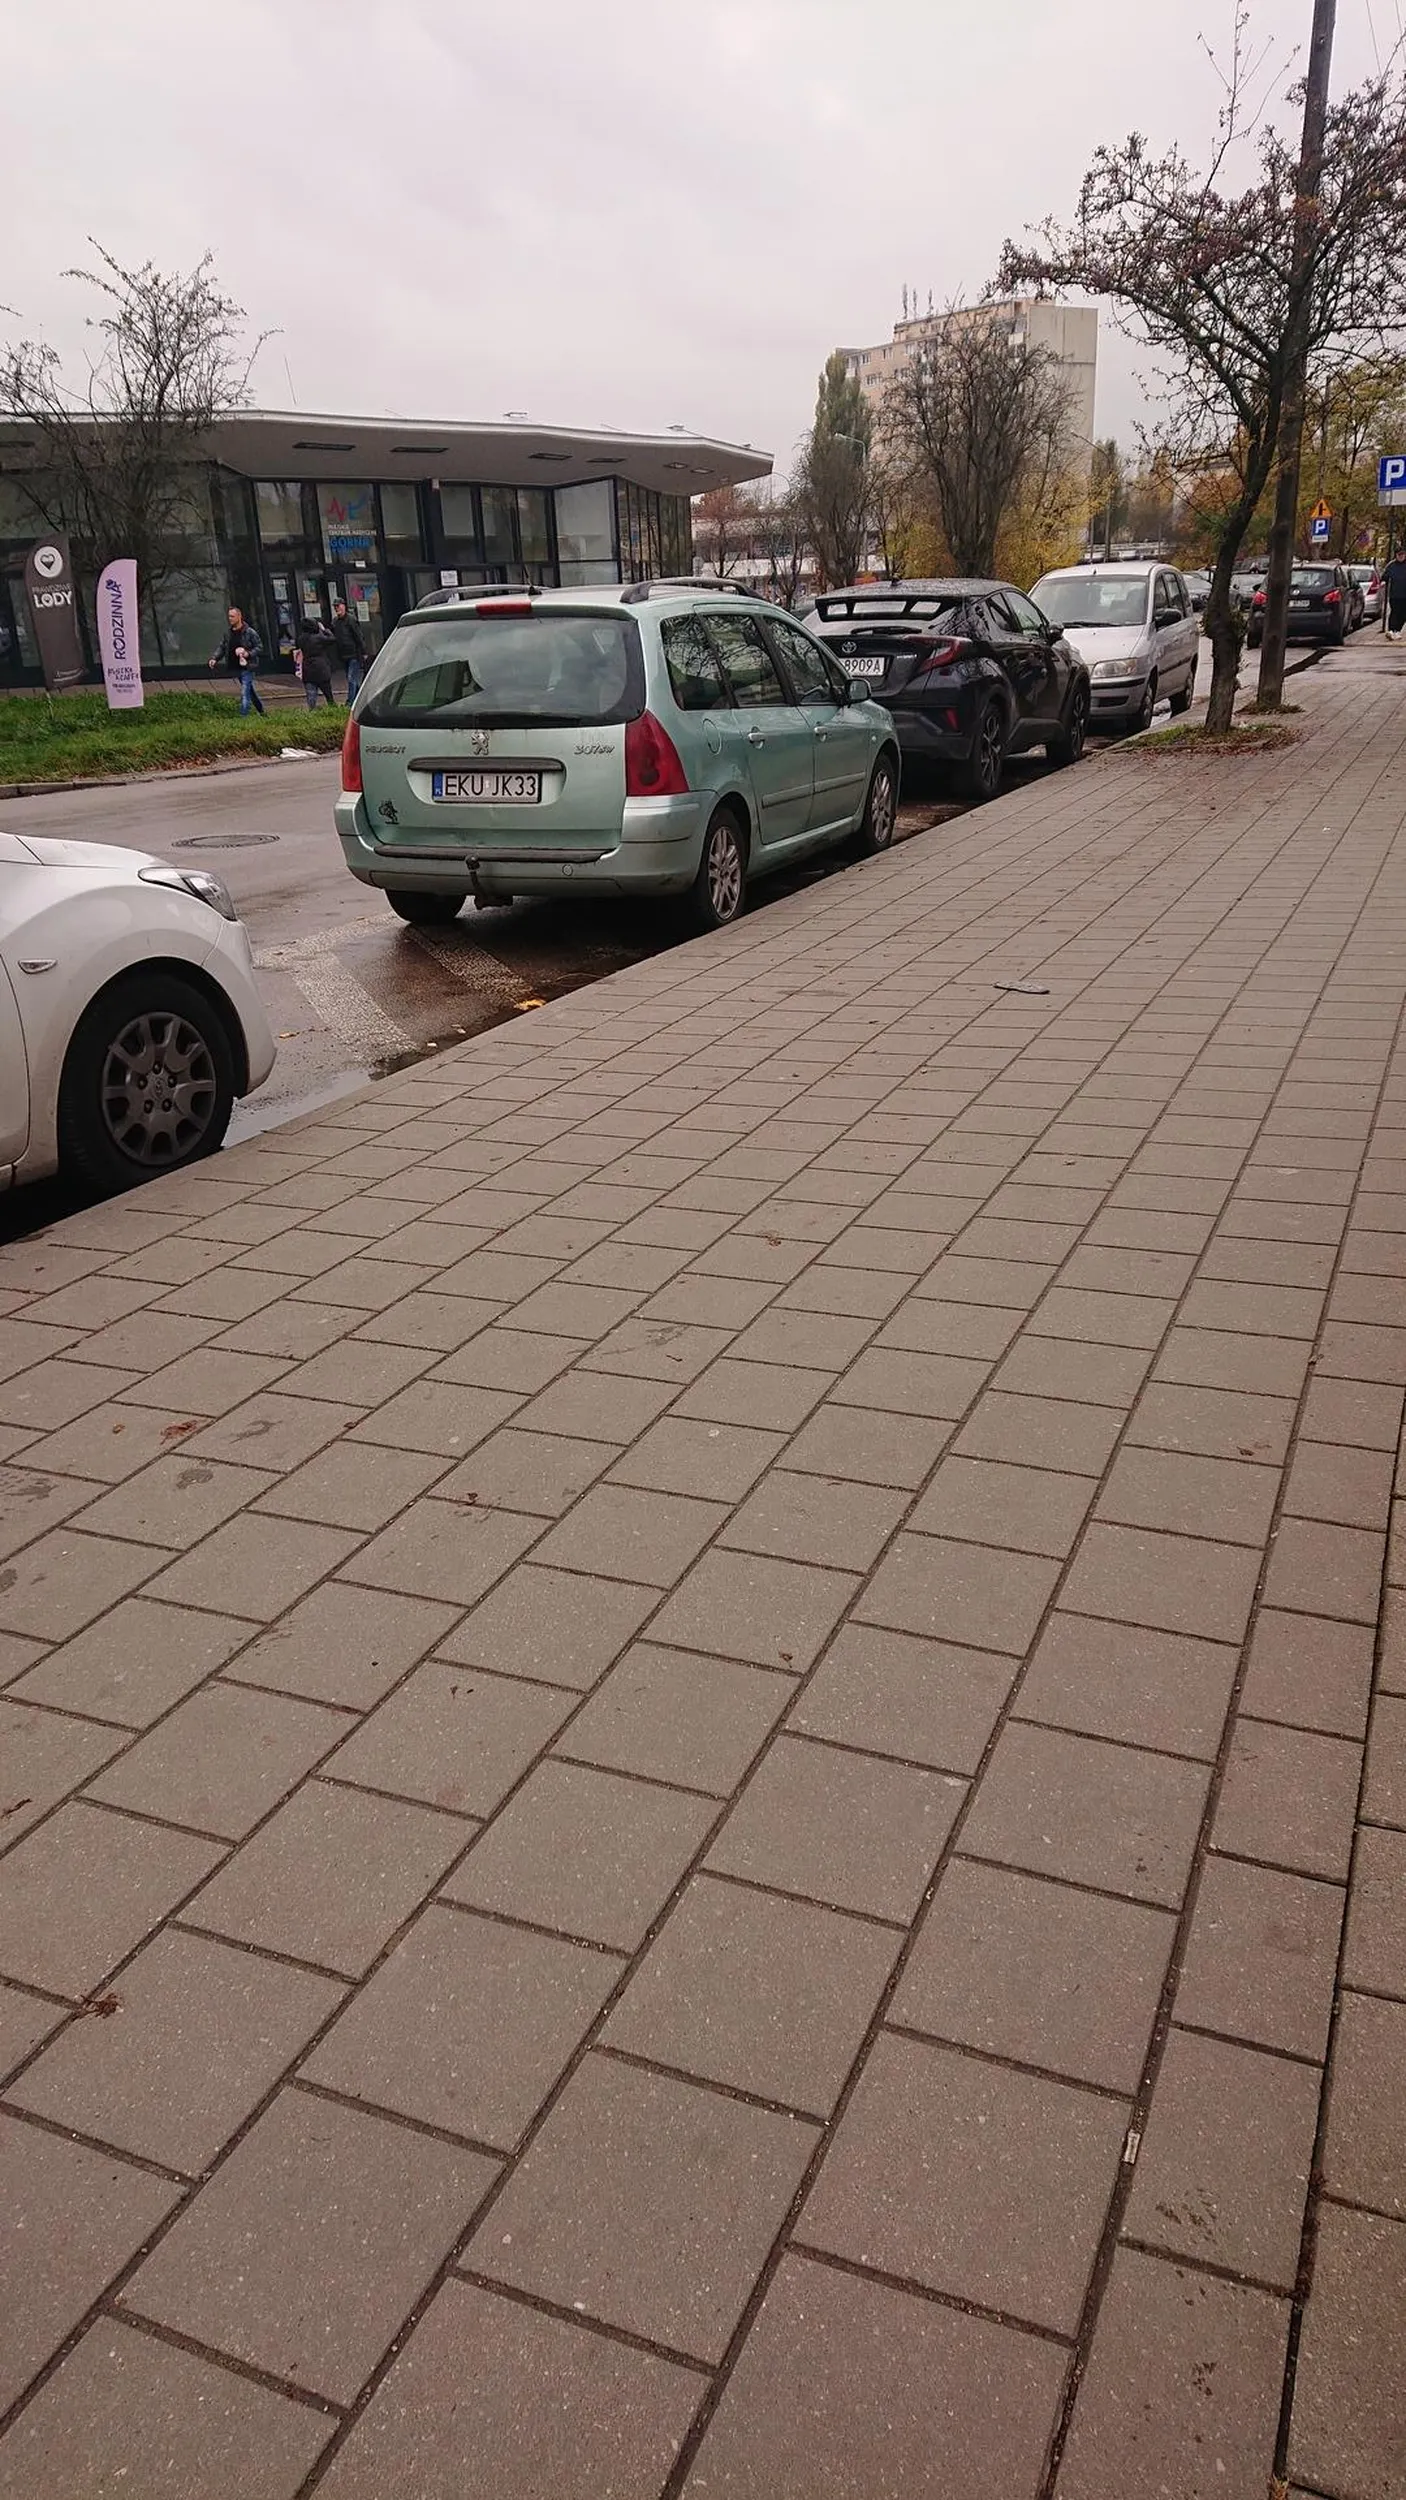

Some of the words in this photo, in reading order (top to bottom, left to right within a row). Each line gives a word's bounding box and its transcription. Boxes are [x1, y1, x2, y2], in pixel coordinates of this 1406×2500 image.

[1385, 459, 1405, 486] P
[1315, 519, 1326, 534] P
[33, 591, 72, 608] LODY
[111, 582, 126, 660] RODZINNA
[365, 744, 406, 754] PEUGEOT
[444, 775, 484, 796] EKU
[491, 775, 536, 797] JK33
